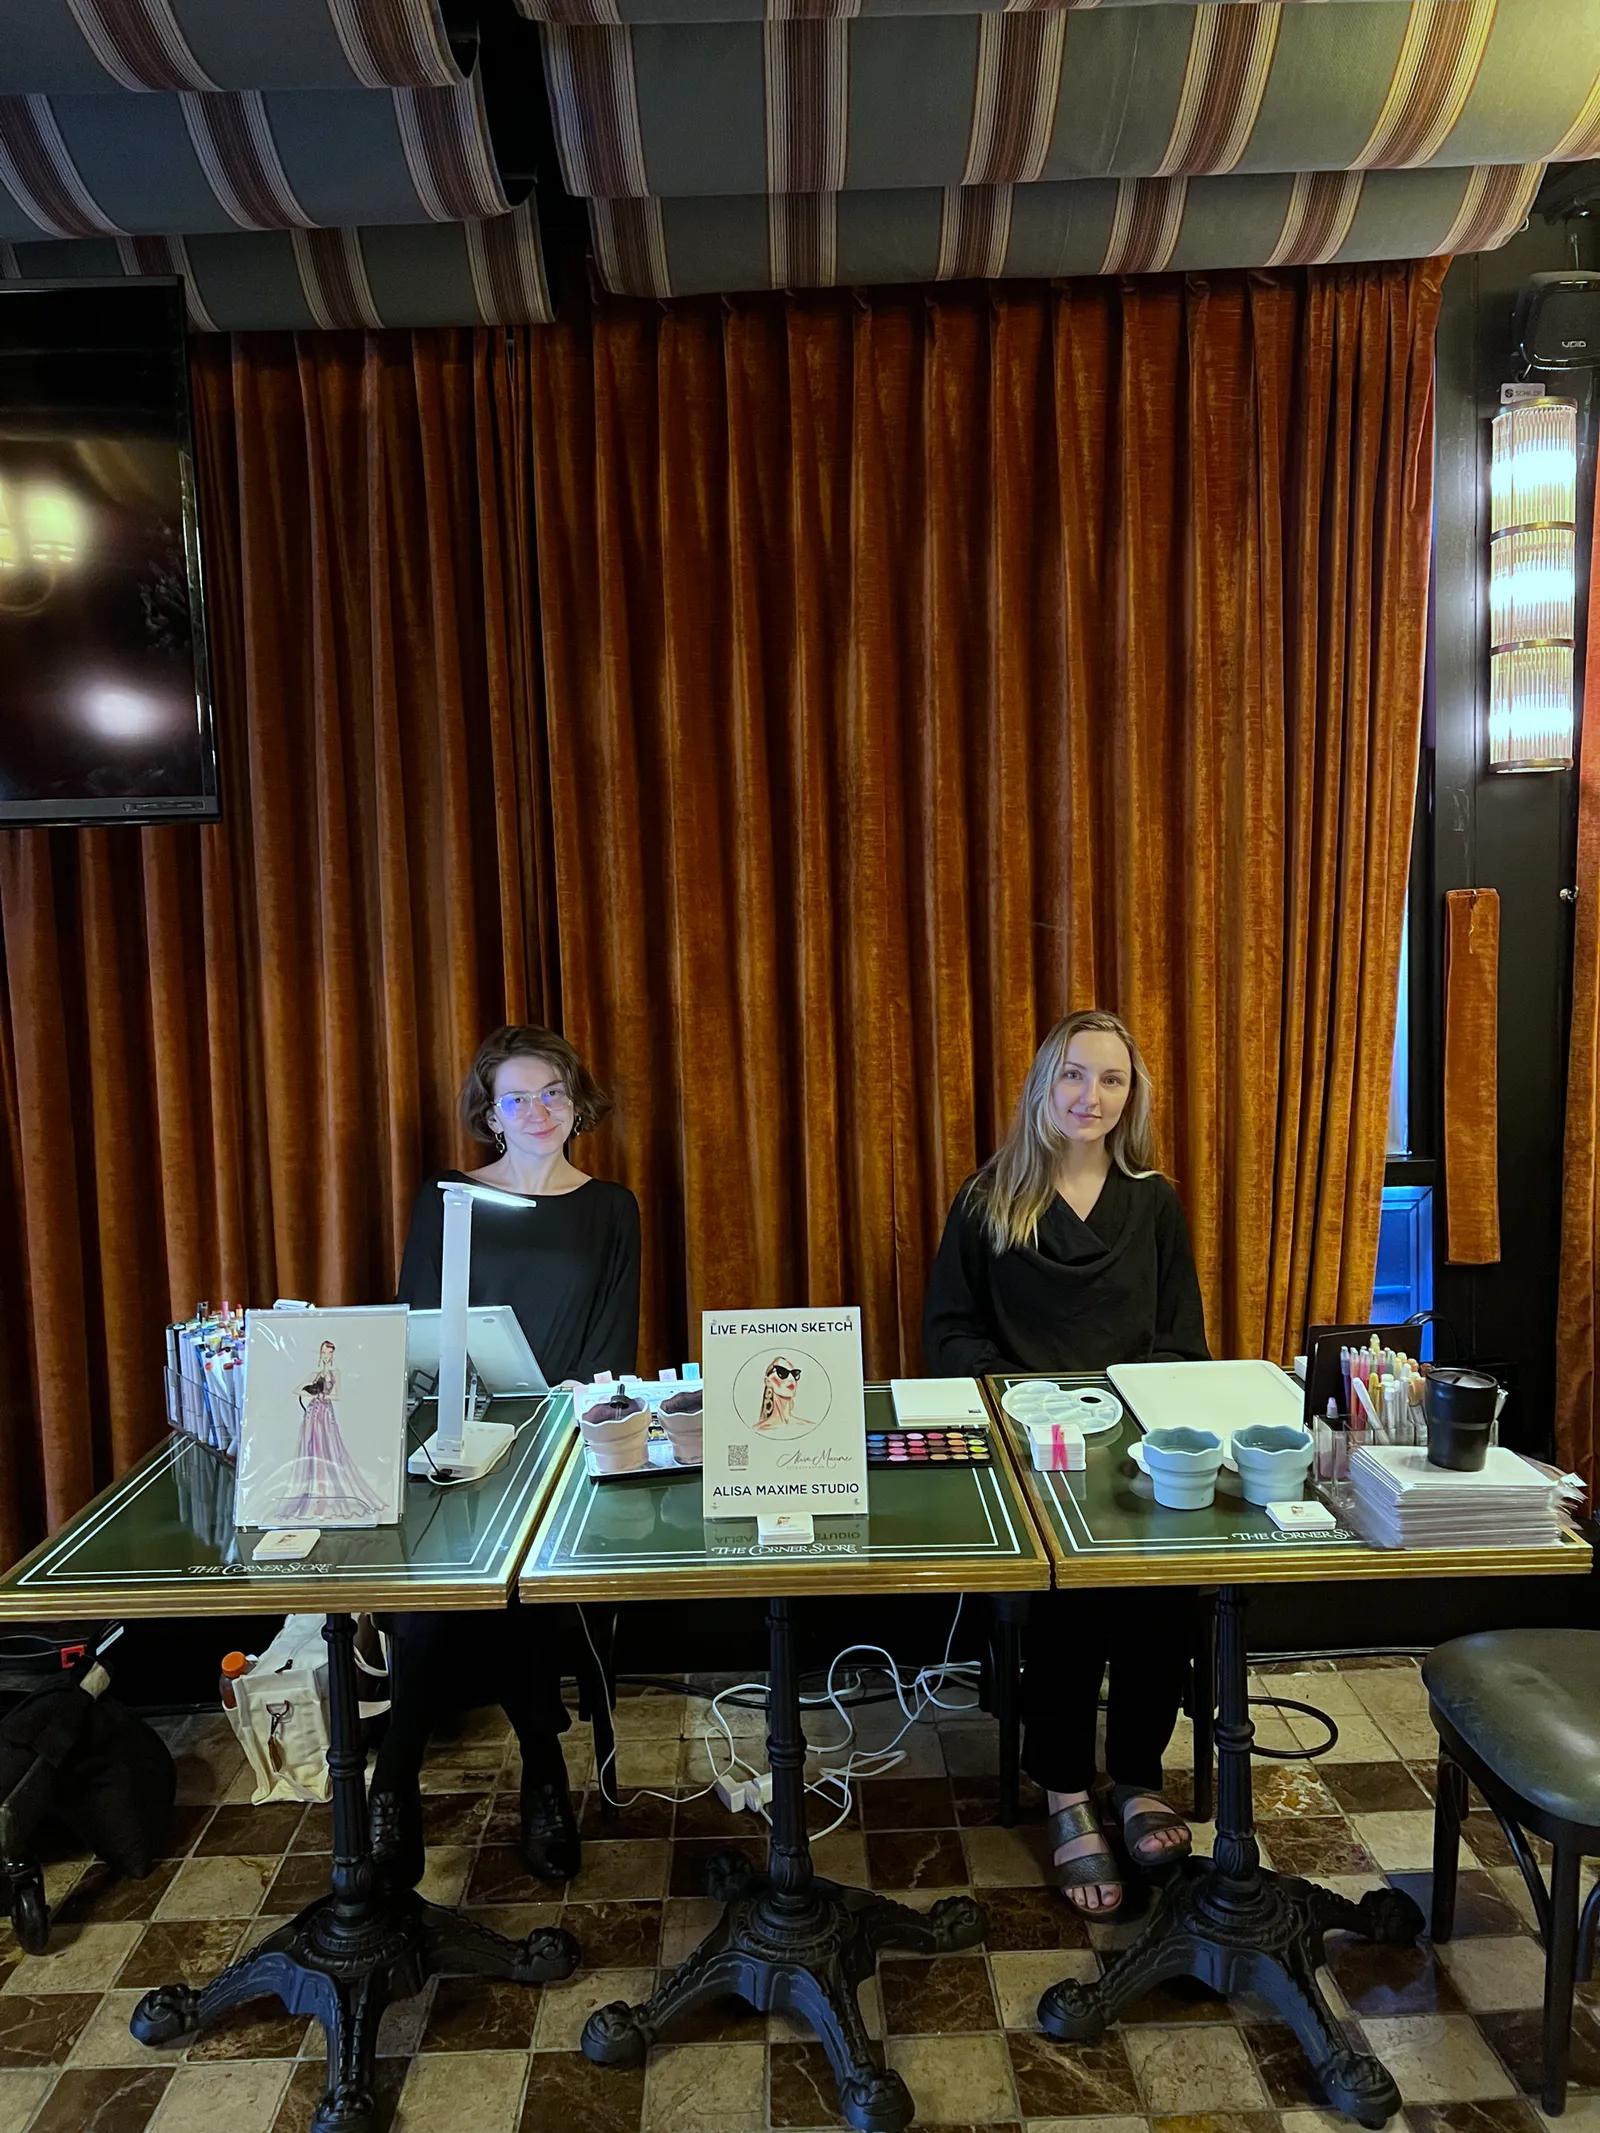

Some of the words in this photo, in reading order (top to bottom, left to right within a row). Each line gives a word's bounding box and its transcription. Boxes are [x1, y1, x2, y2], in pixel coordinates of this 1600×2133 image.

[1561, 340, 1586, 348] VOID
[710, 1324, 737, 1335] LIVE
[741, 1323, 797, 1335] FASHION
[801, 1321, 853, 1333] SKETCH
[713, 1485, 752, 1497] ALISA
[756, 1484, 808, 1496] MAXIME
[811, 1483, 860, 1494] STUDIO
[1231, 1532, 1270, 1541] THE
[1271, 1530, 1335, 1542] CORNER
[711, 1546, 747, 1555] THE
[748, 1544, 808, 1556] CORNER
[809, 1543, 858, 1554] STORE
[188, 1565, 223, 1574] THE
[221, 1563, 283, 1575] CORNER
[281, 1562, 333, 1574] STORE
